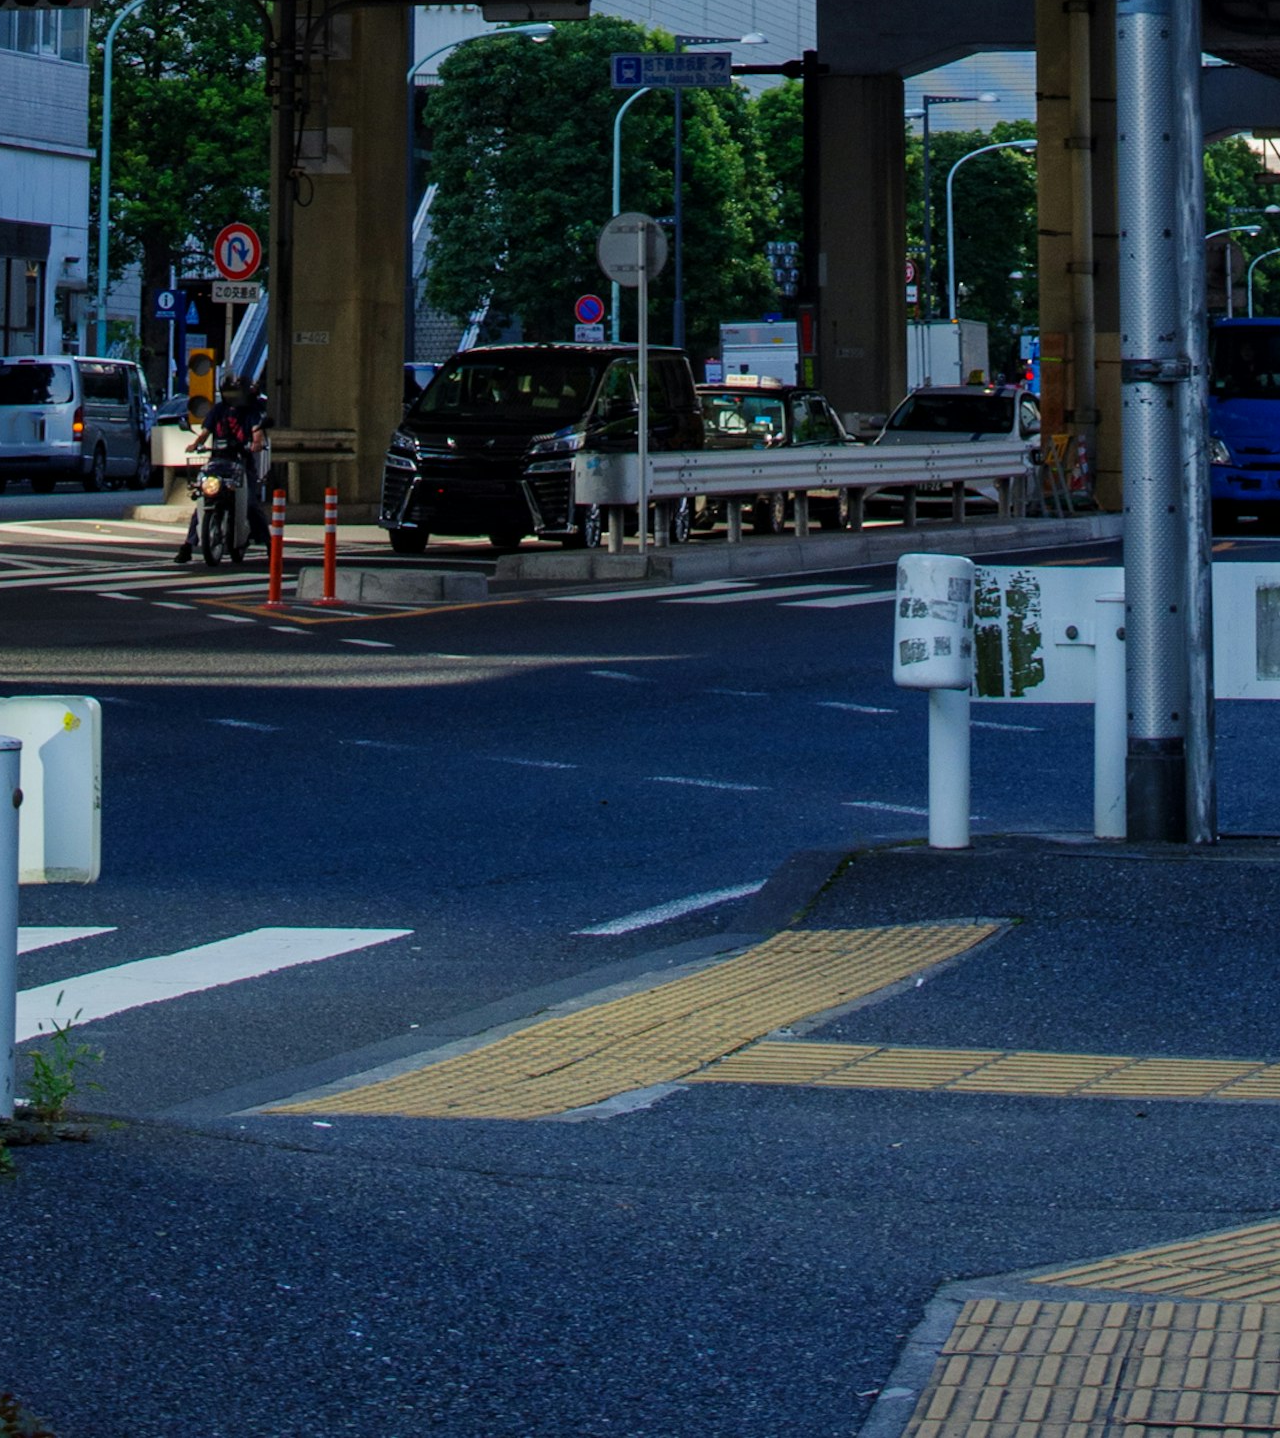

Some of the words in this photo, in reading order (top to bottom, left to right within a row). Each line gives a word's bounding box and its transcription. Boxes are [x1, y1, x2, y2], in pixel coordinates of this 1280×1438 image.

[215, 286, 257, 299] この交差点
